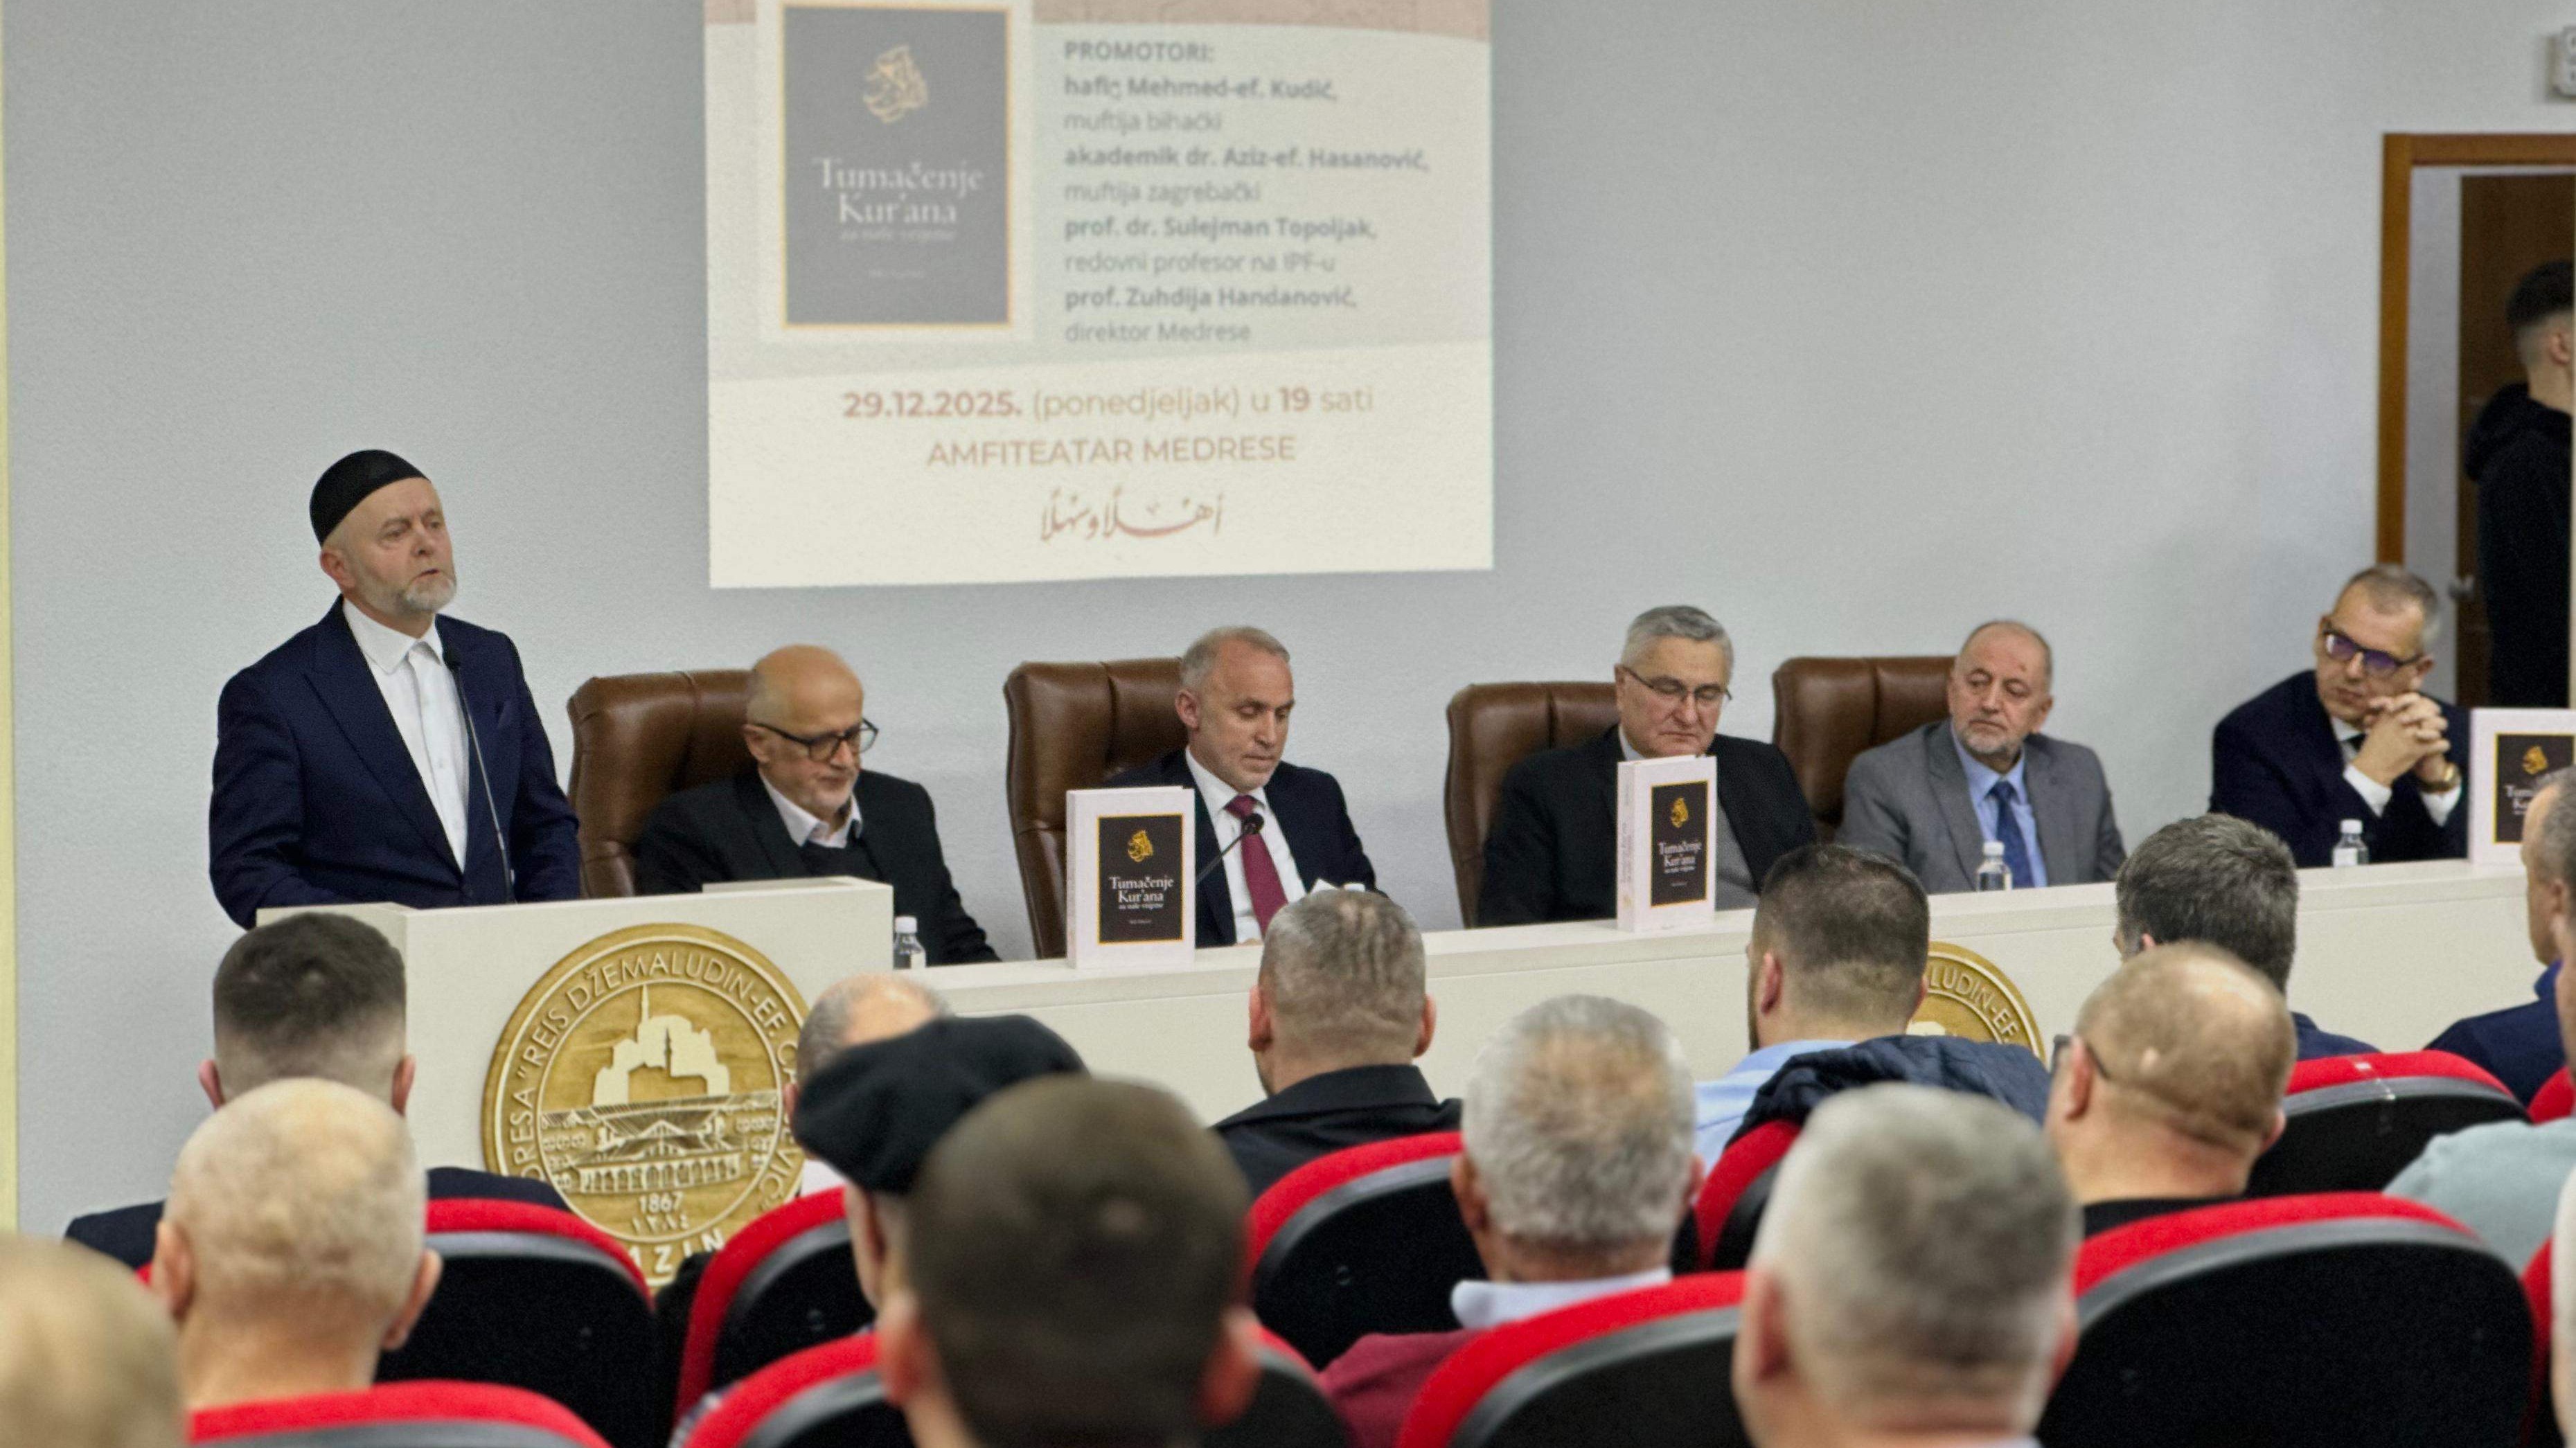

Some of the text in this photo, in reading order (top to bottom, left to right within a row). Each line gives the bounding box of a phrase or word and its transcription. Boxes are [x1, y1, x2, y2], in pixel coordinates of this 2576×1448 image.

[1065, 42, 1214, 62] PROMOTORI:
[1128, 76, 1265, 98] Mehmed-ef.
[1270, 79, 1337, 101] Kudić,
[1065, 111, 1140, 135] muftija
[1065, 145, 1429, 171] akademik dr. Aziz-ef. Hasanović,
[812, 158, 985, 199] Tumačenje
[1065, 181, 1140, 206] muftija
[1065, 215, 1377, 242] prof. dr. Sulejman Topoljak,
[1065, 252, 1334, 276] redovni profesor na IPF-u
[1065, 285, 1356, 312] prof. Zuhdija Handanović,
[1065, 322, 1250, 342] direktor Medrese
[842, 386, 1374, 421] 29.12.2025. (ponedjeljak) u 19 sati
[927, 435, 1297, 466] AMFITEATAR MEDRESE
[1108, 874, 1175, 891] Tumačenje
[565, 951, 787, 1038] DŽEMALUDIN-EF.
[639, 1191, 684, 1213] 1867
